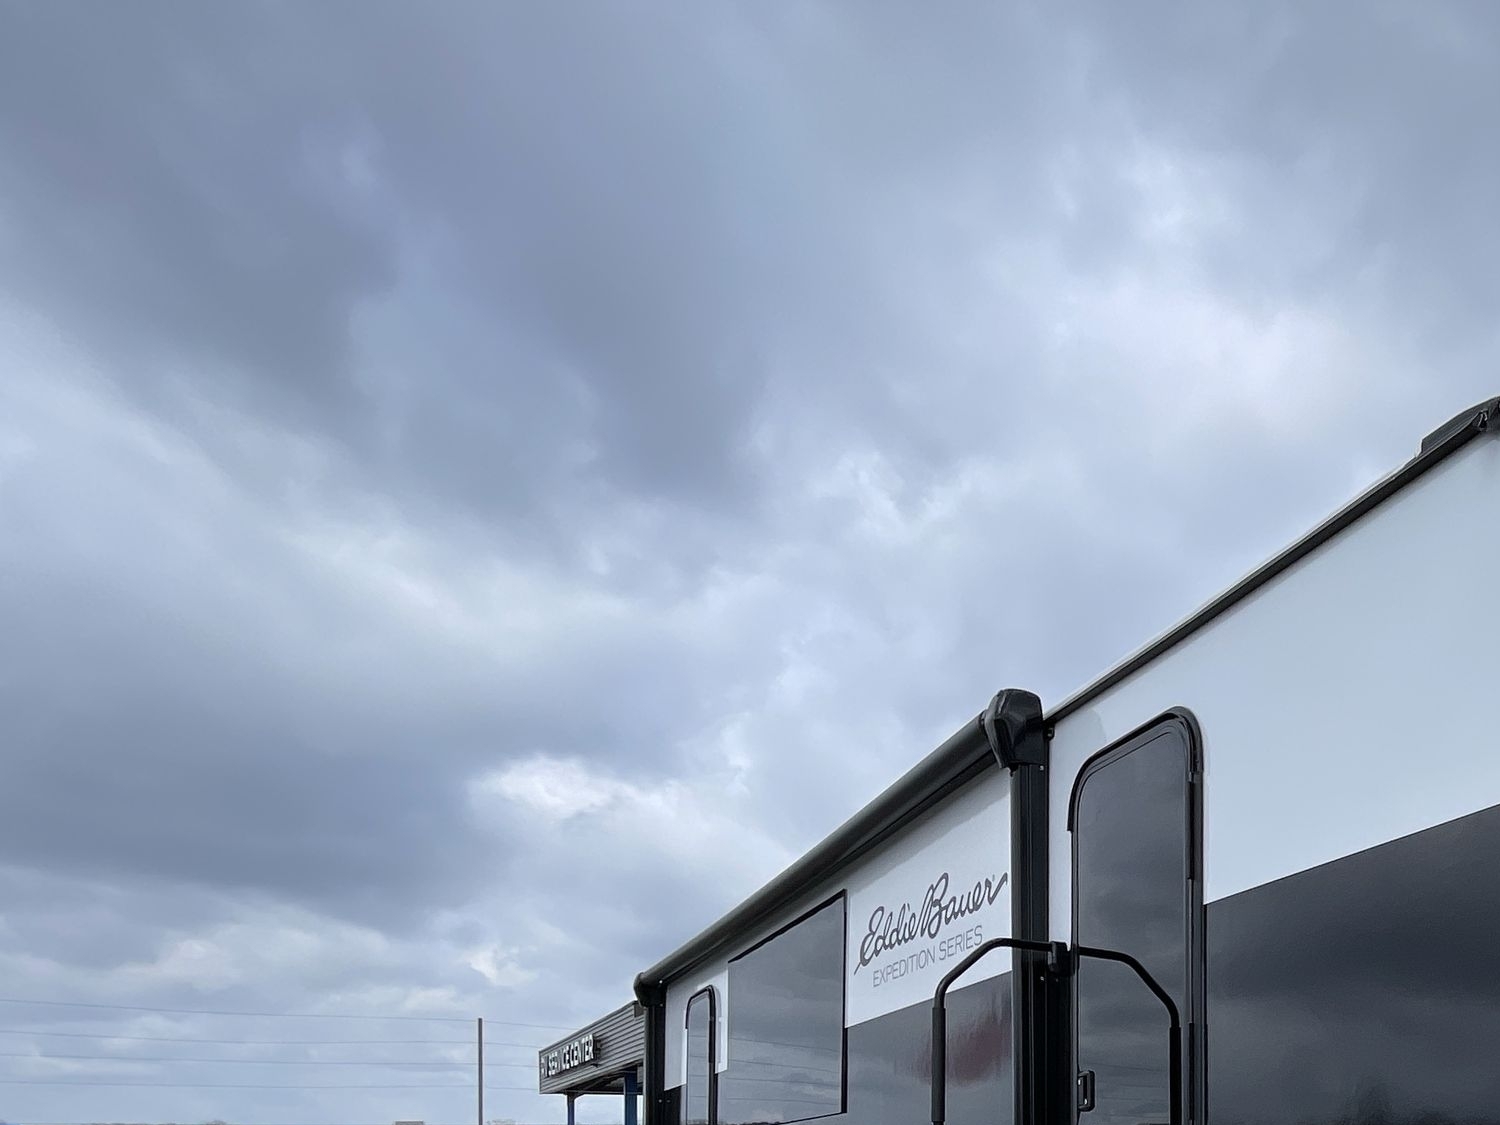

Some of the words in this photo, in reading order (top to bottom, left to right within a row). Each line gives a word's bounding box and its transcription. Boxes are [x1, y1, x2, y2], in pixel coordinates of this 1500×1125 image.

[854, 903, 919, 976] Eddie
[920, 872, 1008, 939] Bauer
[872, 946, 936, 988] EXPEDITION
[938, 925, 983, 965] SERIES
[570, 1034, 594, 1067] CENTER
